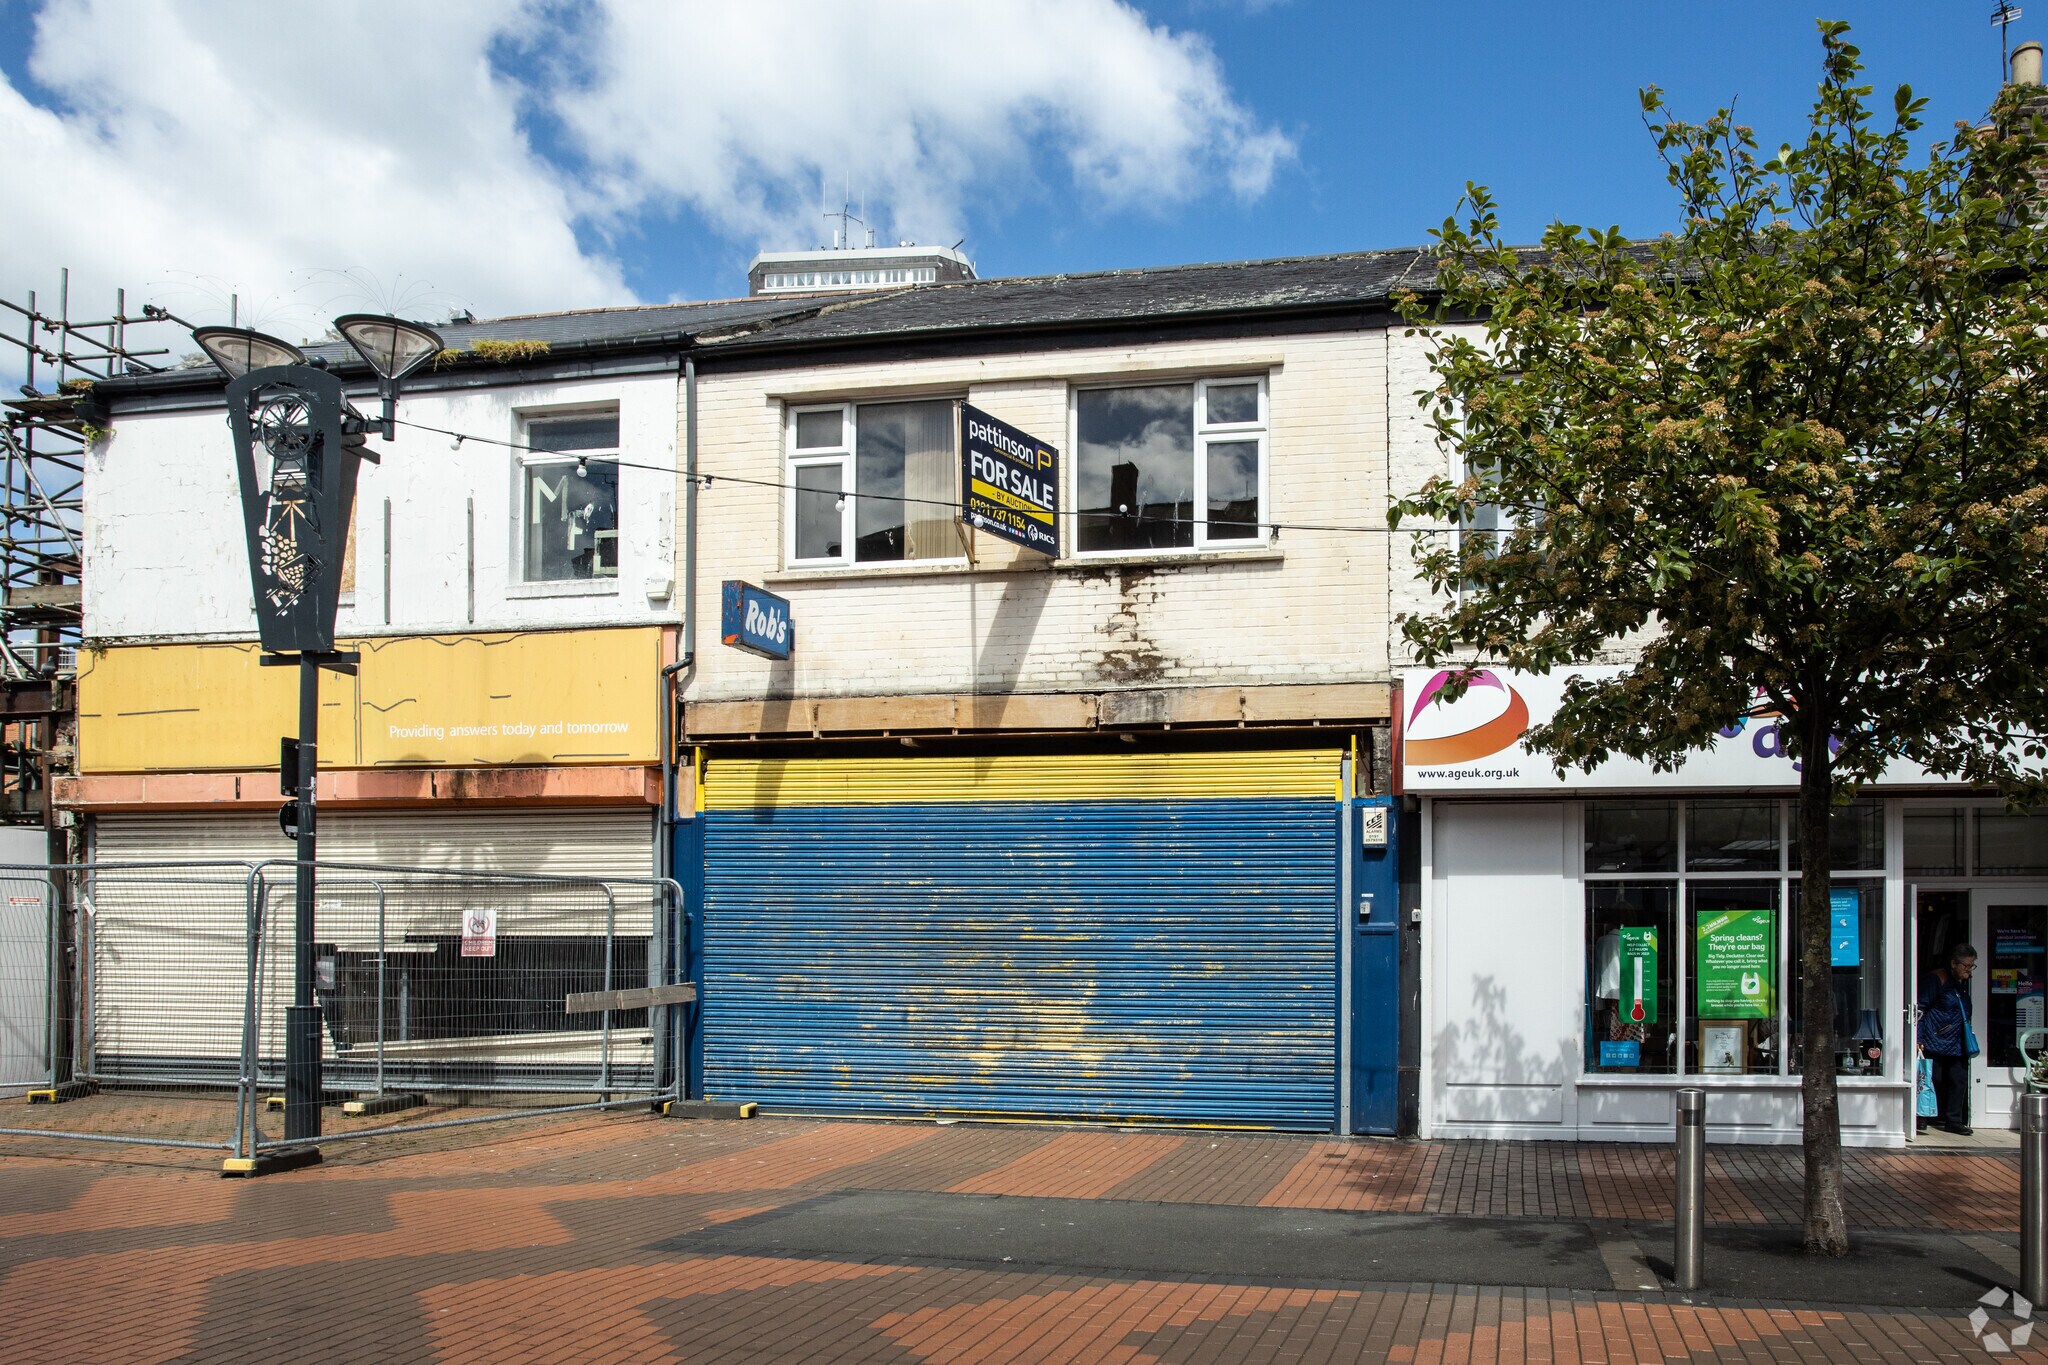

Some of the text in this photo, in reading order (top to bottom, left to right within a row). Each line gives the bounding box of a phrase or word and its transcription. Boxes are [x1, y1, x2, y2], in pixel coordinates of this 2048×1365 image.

[969, 419, 1034, 465] pattinson
[970, 449, 1054, 511] FOR SALE
[997, 491, 1005, 503] BY
[992, 505, 1007, 522] 737
[1007, 512, 1026, 530] 1154
[1038, 531, 1056, 545] RICS
[745, 599, 787, 644] Rob's
[389, 721, 629, 741] Providing answers today and tomorrow
[1418, 767, 1520, 780] www.ageuk.org.uk
[1366, 812, 1382, 827] CES
[1710, 933, 1763, 943] Spring cleans?
[1708, 943, 1736, 952] They're
[1751, 942, 1766, 951] bag
